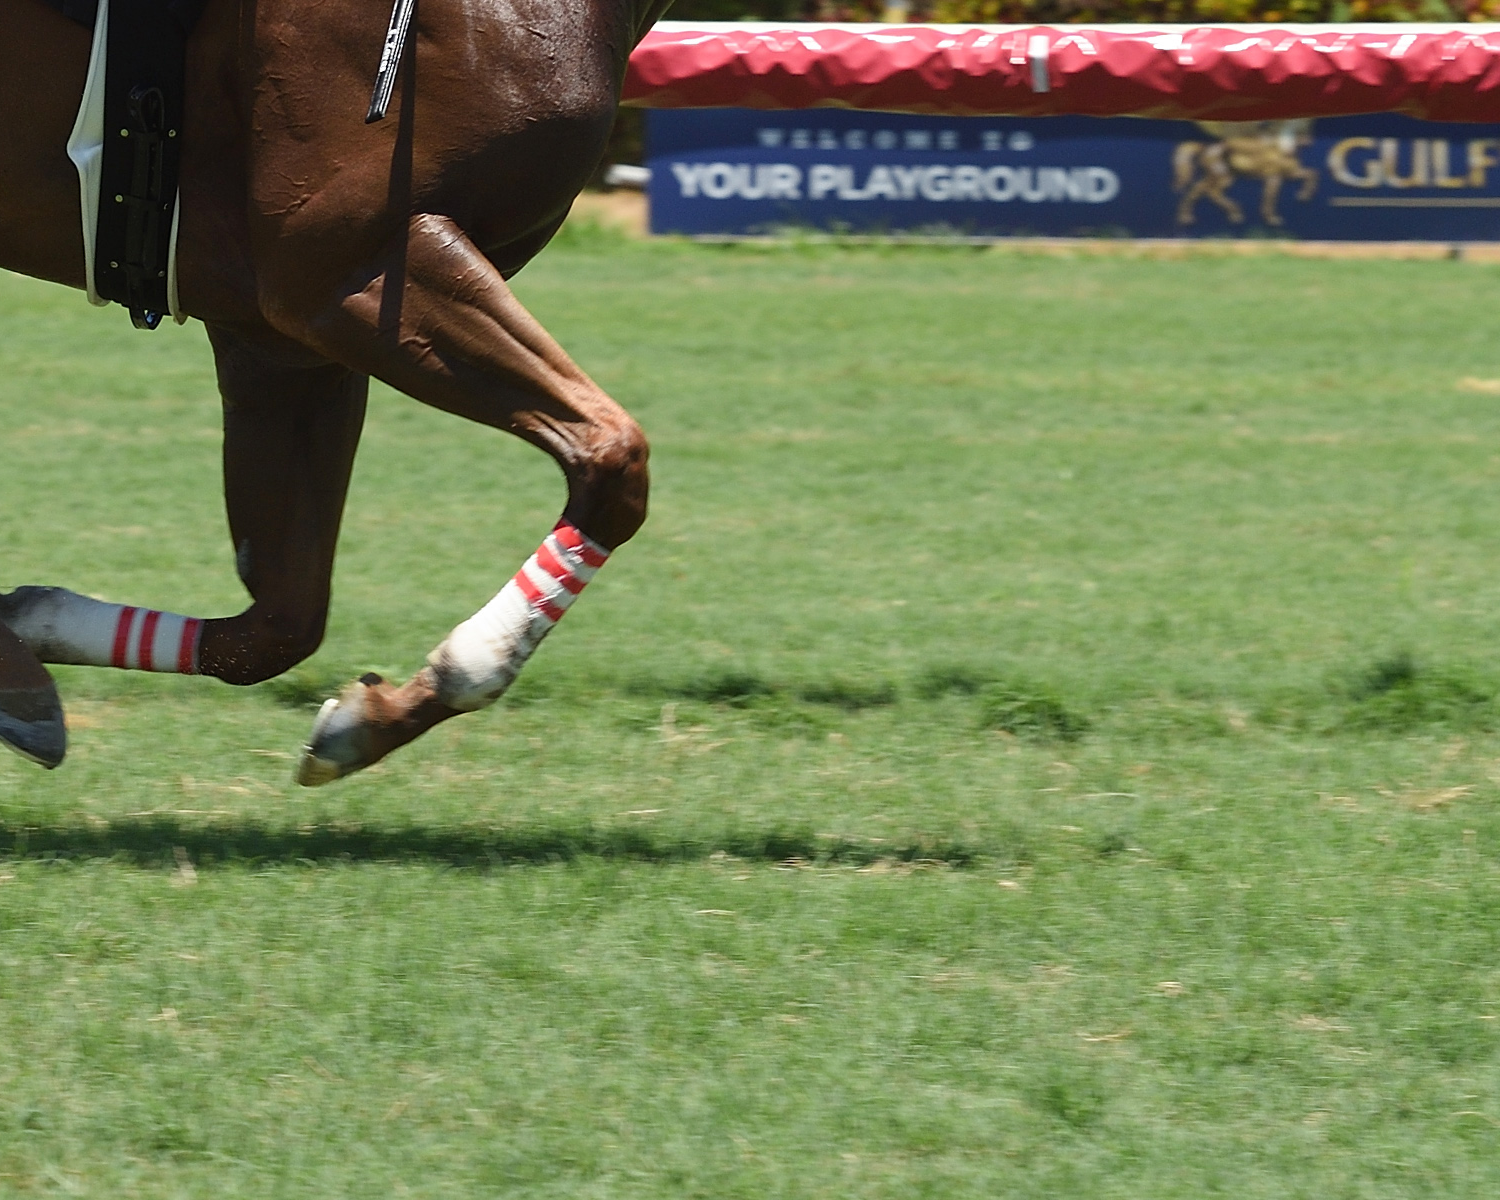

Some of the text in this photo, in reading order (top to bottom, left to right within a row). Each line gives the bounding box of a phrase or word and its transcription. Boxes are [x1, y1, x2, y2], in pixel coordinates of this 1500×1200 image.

[670, 161, 1120, 203] YOUR PLAYGROUND
[1327, 136, 1500, 188] GULF
